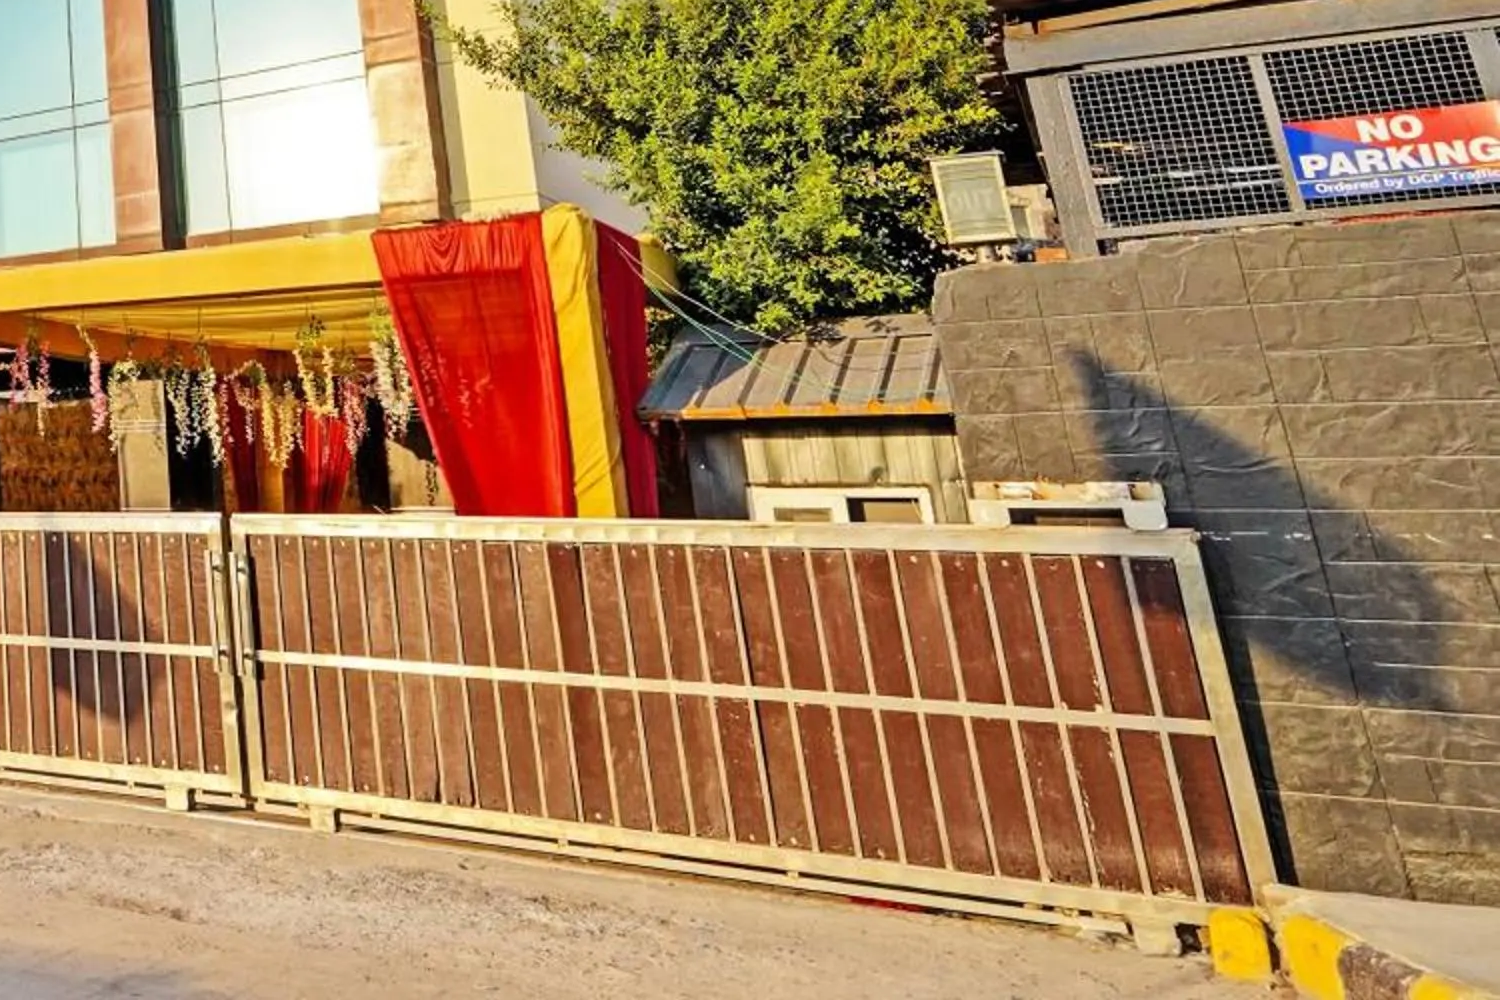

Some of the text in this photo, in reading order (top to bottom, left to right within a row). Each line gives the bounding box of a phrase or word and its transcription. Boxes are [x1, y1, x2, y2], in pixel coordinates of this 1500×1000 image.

[1356, 114, 1424, 143] NO
[1299, 136, 1500, 179] PARKING
[1315, 178, 1381, 194] Ordered
[1384, 176, 1405, 190] by
